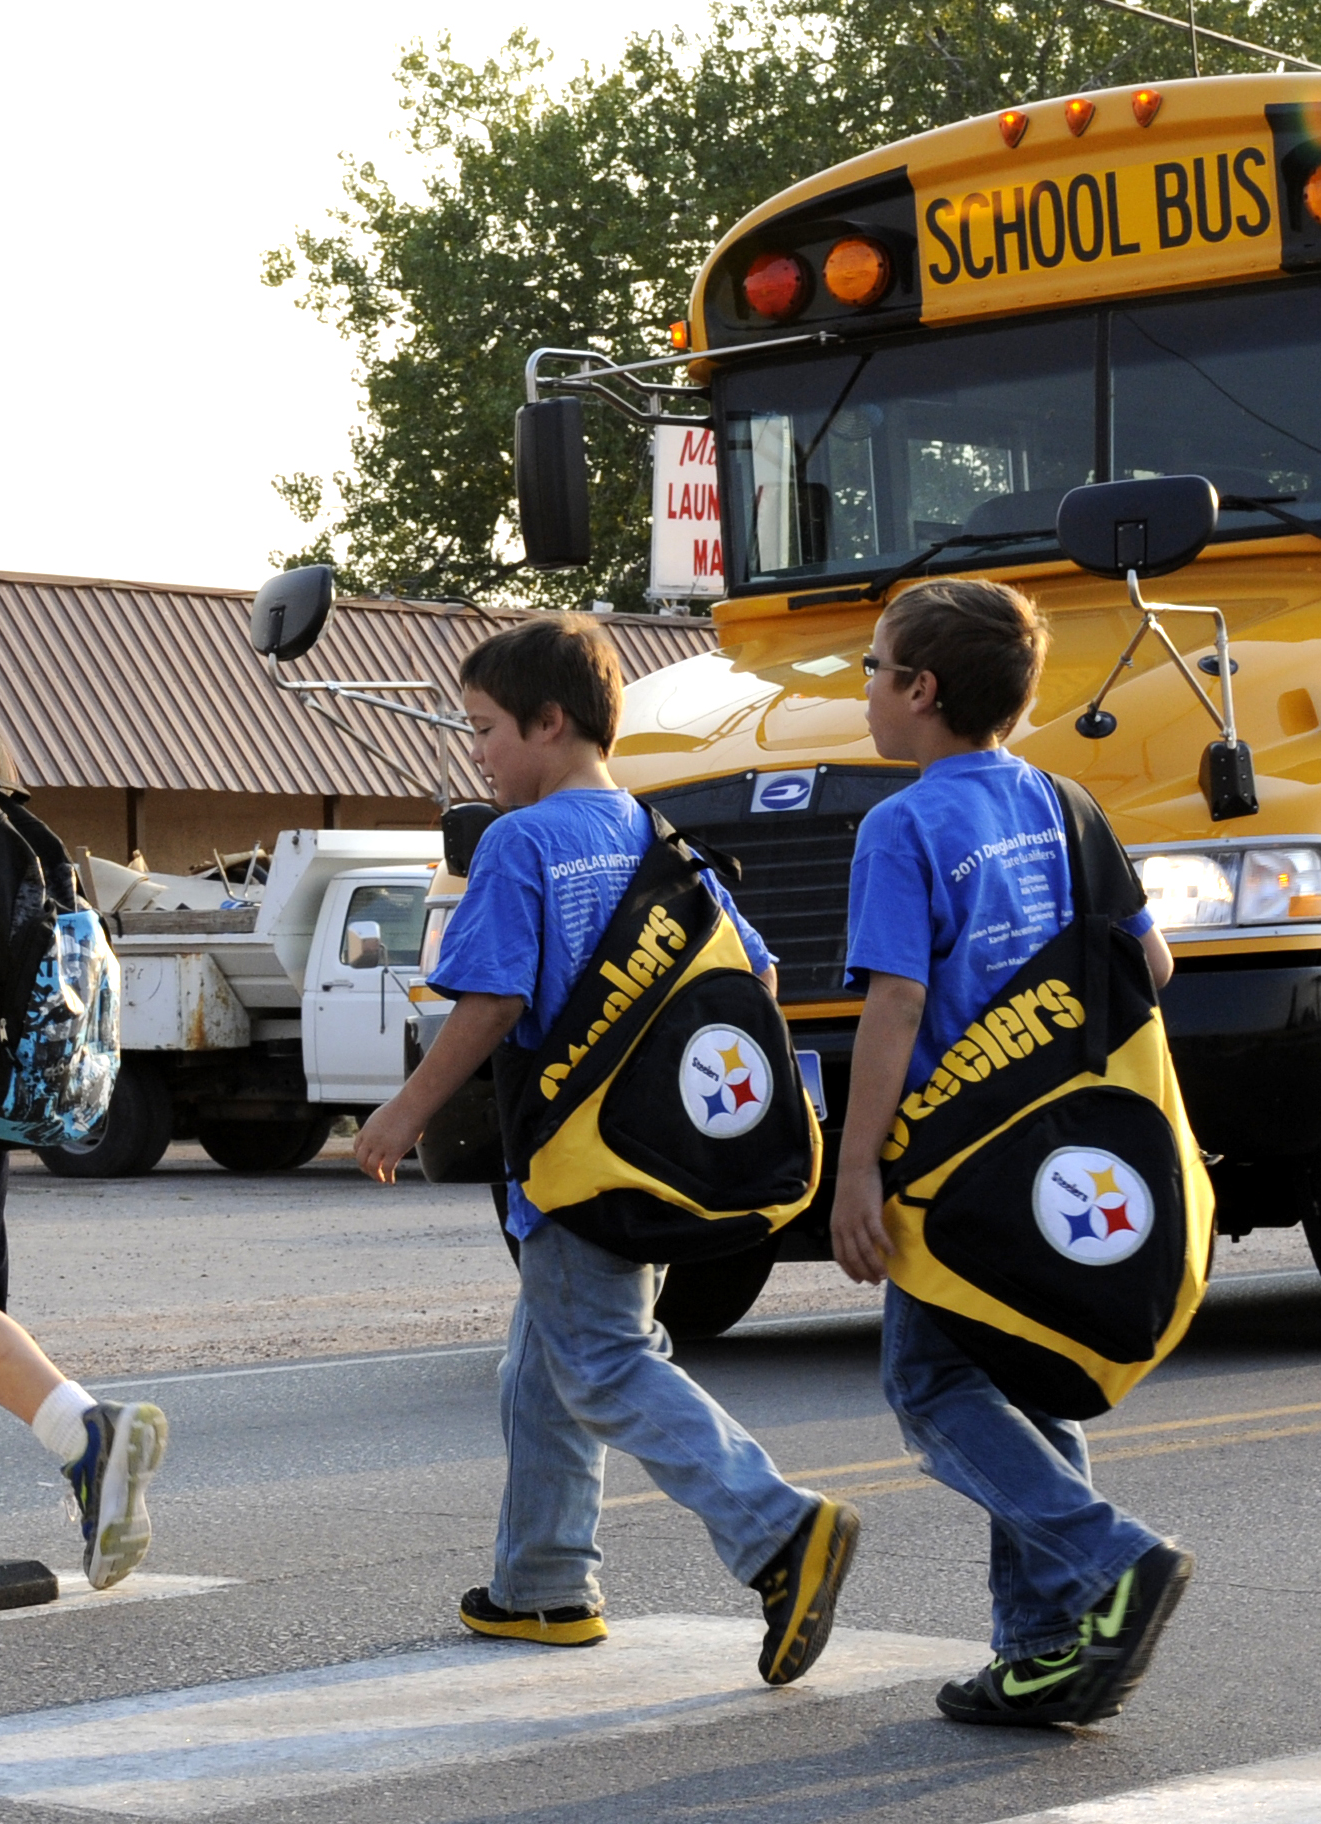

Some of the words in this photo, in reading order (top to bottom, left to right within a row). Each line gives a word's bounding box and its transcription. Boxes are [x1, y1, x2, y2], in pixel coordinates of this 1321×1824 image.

[925, 171, 1141, 285] SCHOOL
[1154, 147, 1271, 250] BUS
[550, 854, 607, 879] DOUGLAS
[950, 849, 984, 883] 2011
